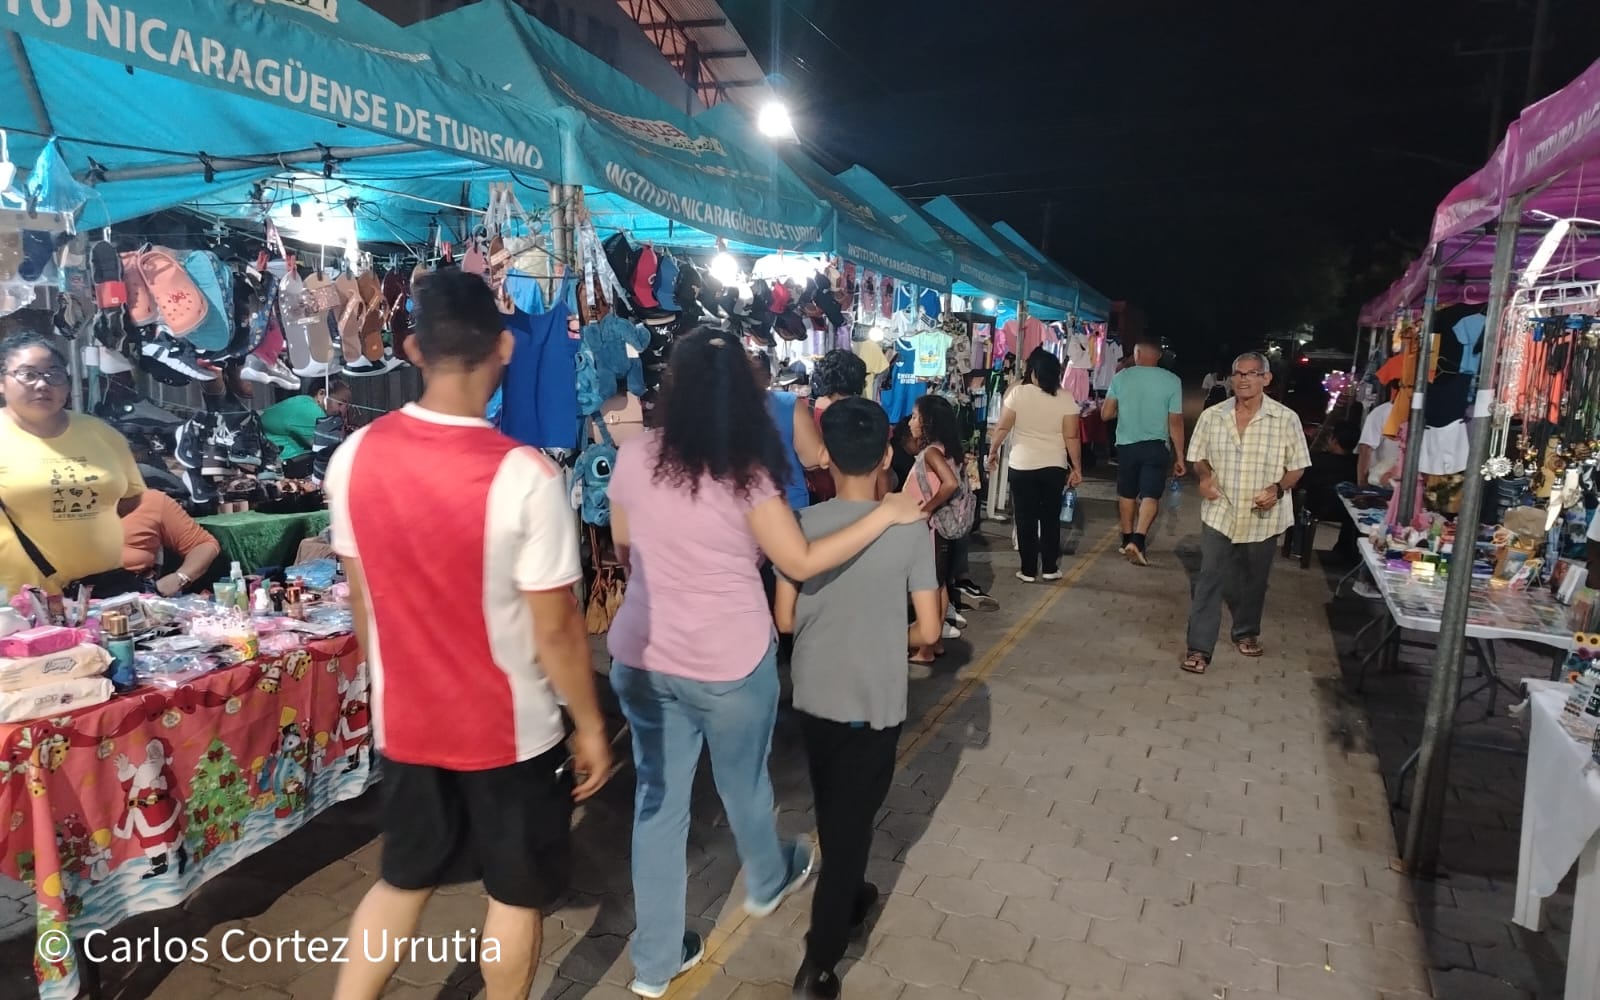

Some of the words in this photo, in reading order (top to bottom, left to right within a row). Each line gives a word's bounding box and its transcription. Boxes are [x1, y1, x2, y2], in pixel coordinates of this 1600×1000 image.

[87, 0, 388, 129] NICARAGÜENSE
[395, 102, 432, 142] DE
[435, 114, 544, 170] TURISMO
[605, 161, 680, 213] INSTITUTO
[770, 221, 787, 241] DE
